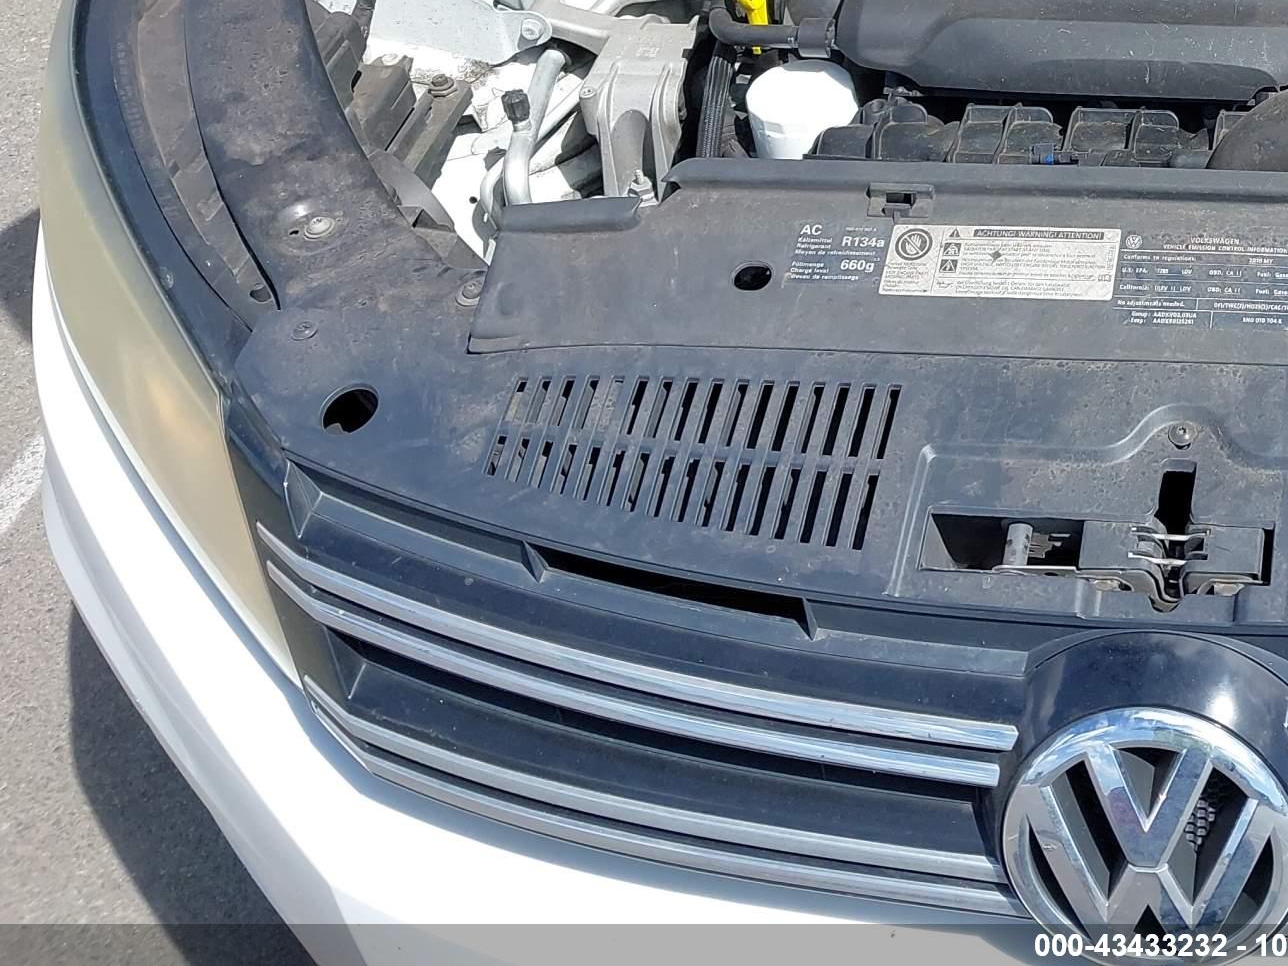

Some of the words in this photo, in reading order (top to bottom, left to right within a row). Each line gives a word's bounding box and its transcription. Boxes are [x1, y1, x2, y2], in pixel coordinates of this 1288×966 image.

[800, 224, 822, 235] AC
[841, 236, 885, 248] R134a
[1191, 237, 1240, 245] VOLKSWAGEN
[1163, 243, 1186, 251] VEHICLE
[1247, 246, 1288, 254] INFORMATION
[840, 259, 875, 273] 660g
